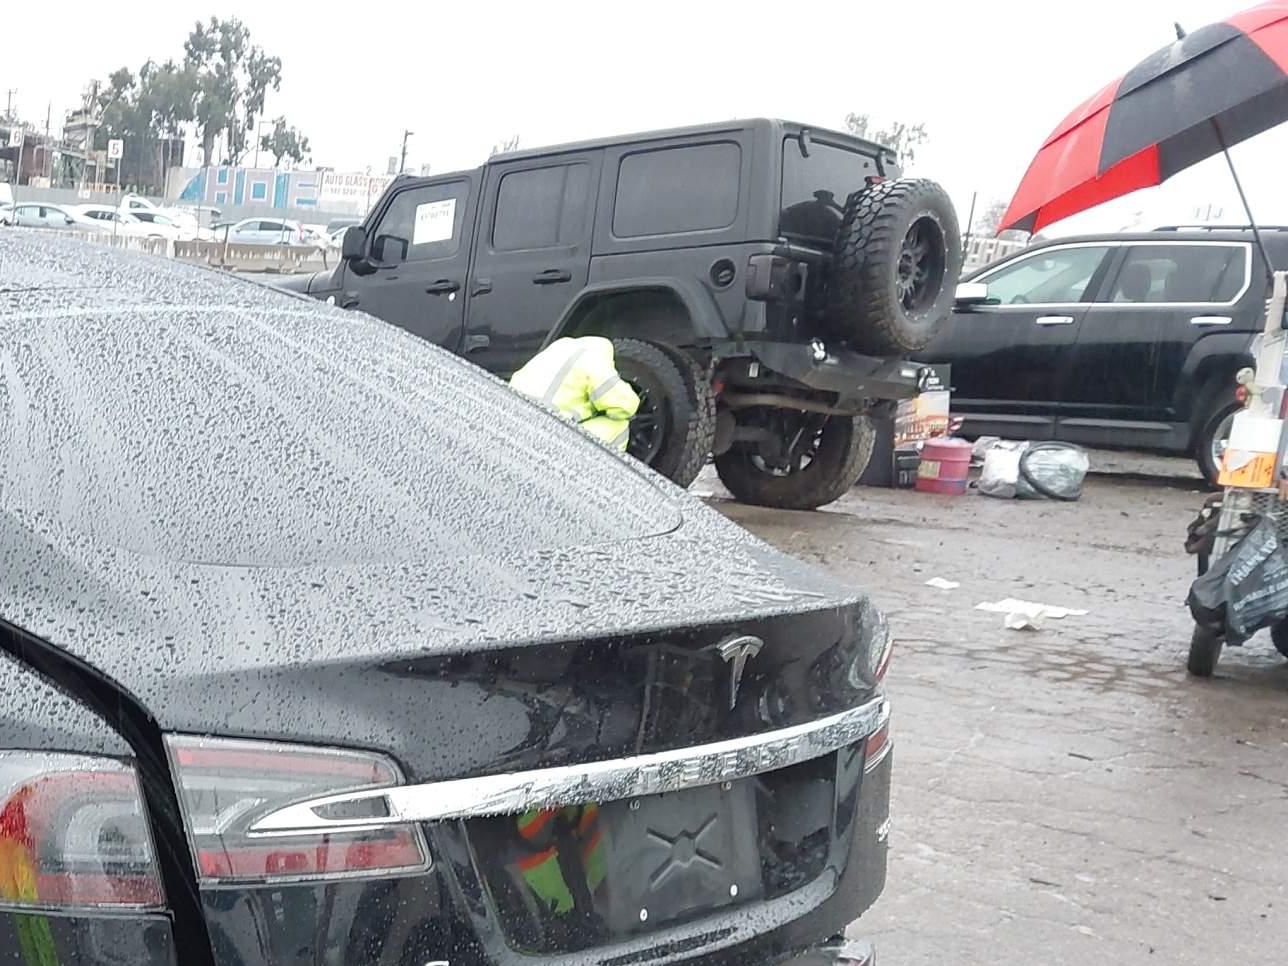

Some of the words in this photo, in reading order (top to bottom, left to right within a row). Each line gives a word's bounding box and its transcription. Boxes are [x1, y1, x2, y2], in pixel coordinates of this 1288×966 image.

[13, 130, 21, 143] 6
[112, 143, 120, 155] 5
[324, 175, 344, 185] AUTO
[345, 175, 368, 187] GLASS
